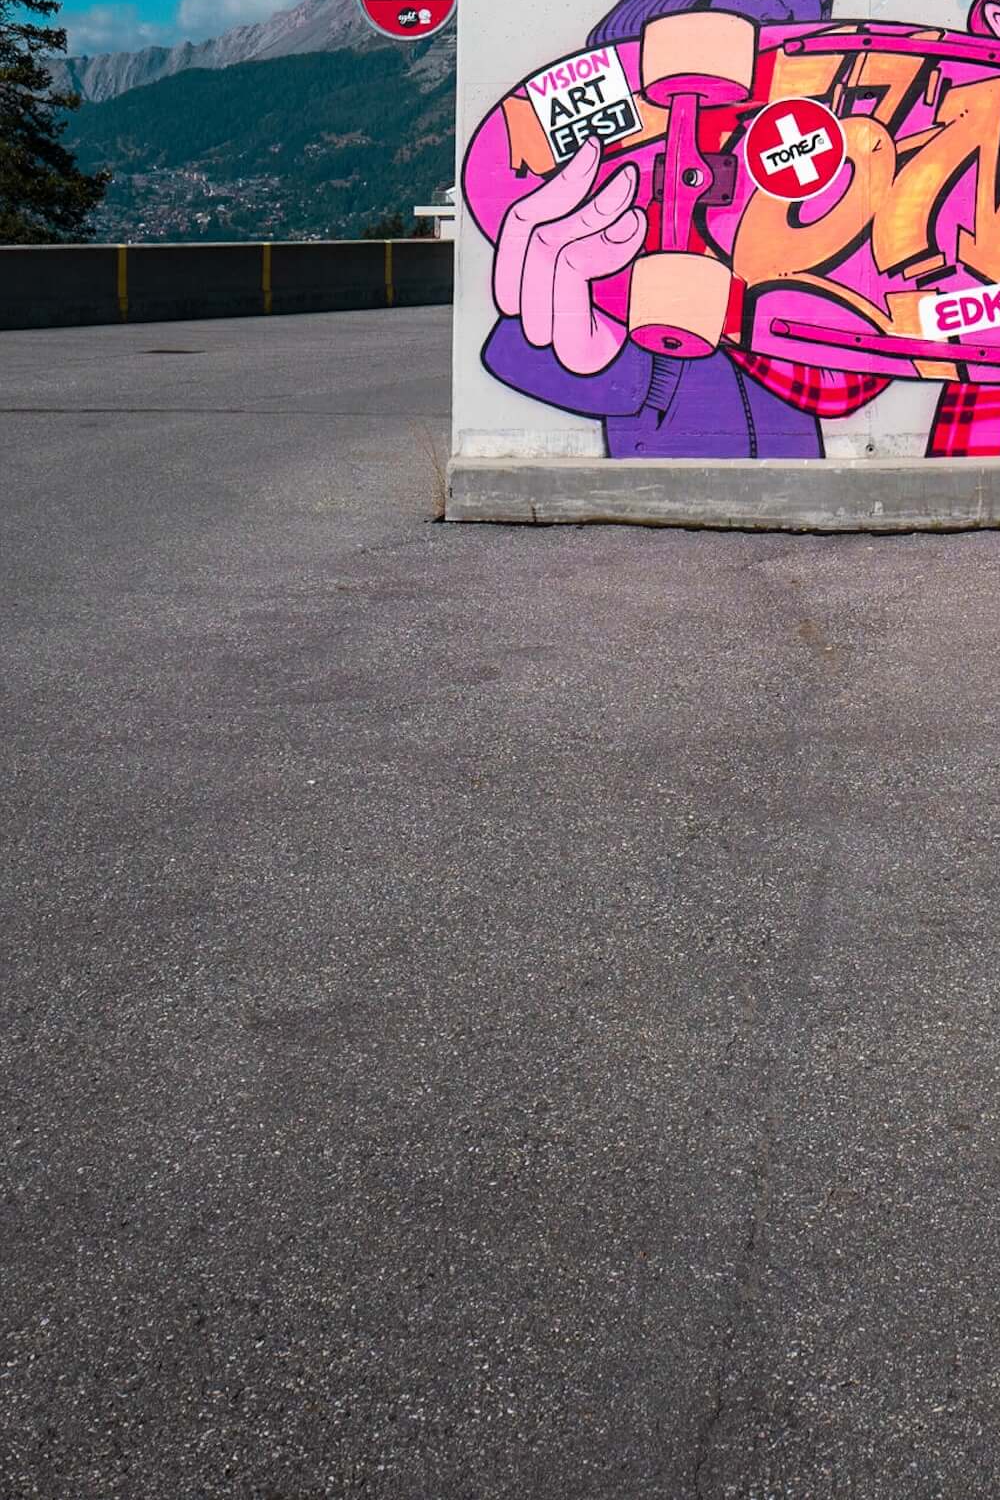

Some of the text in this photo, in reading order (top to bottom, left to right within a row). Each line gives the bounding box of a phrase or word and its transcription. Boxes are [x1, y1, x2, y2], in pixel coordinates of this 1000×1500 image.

[528, 49, 611, 97] VISION
[550, 74, 606, 128] ART
[554, 102, 627, 154] FEST
